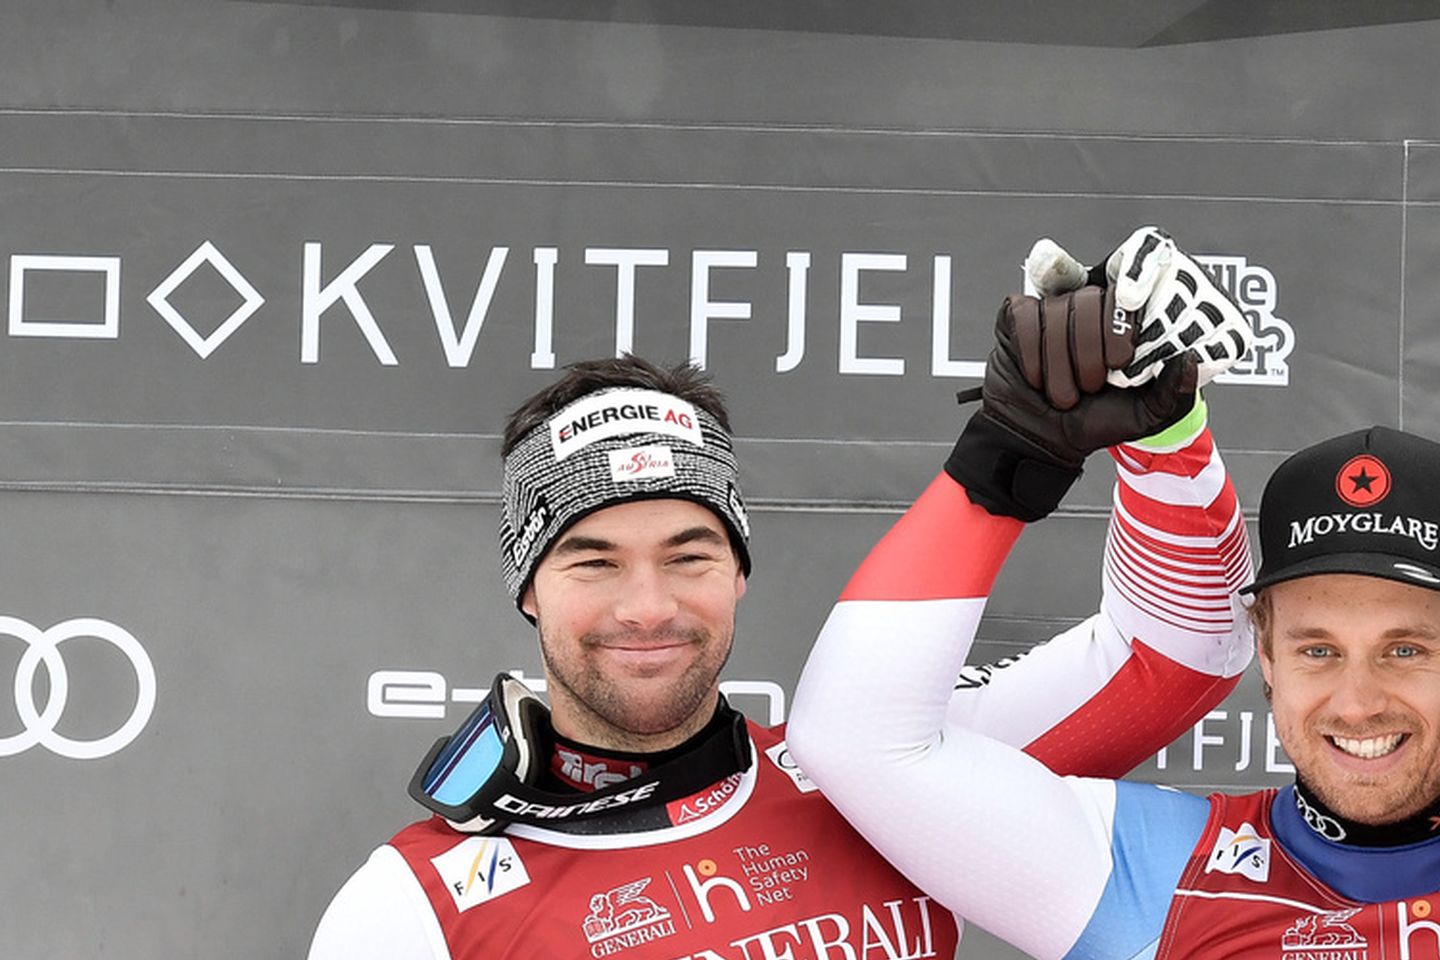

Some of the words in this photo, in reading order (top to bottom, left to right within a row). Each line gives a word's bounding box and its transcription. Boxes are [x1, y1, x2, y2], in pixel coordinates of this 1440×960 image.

[302, 242, 1040, 378] KVITFJEL
[559, 404, 661, 443] ENERGIE
[664, 409, 693, 430] AG
[1288, 512, 1439, 551] MOYGLARE
[733, 843, 771, 862] The
[742, 849, 809, 877] Human
[454, 856, 512, 896] FIS
[749, 866, 809, 892] Safety
[755, 886, 794, 907] Net
[591, 920, 677, 960] GENERALI
